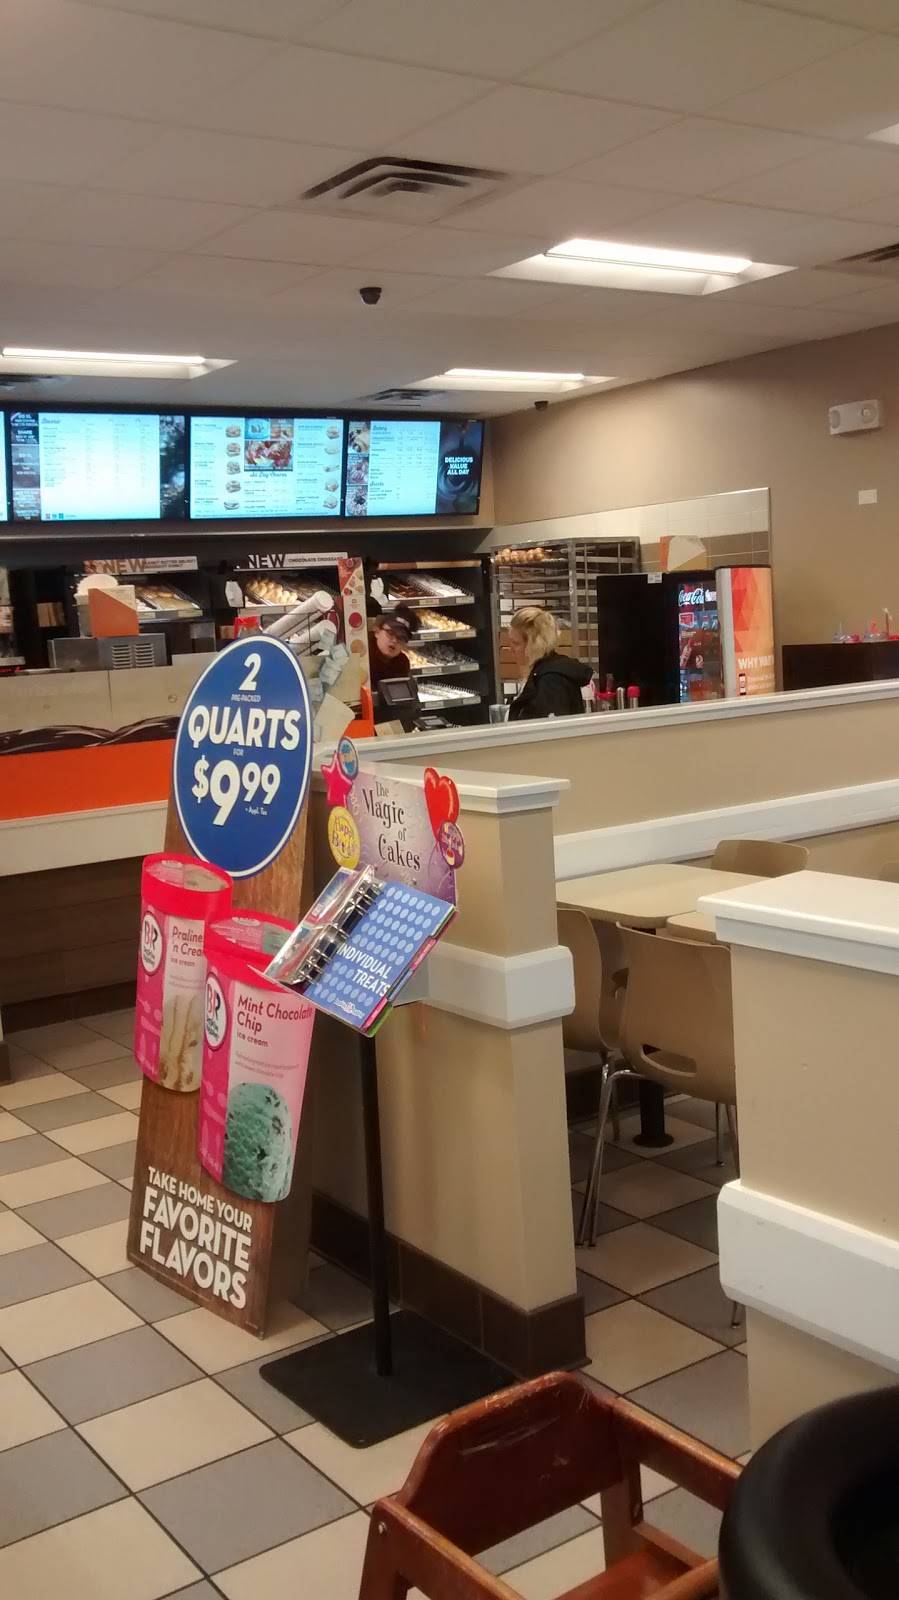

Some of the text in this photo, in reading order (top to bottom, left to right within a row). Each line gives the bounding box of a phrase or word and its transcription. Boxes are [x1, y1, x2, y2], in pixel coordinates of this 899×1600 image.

[102, 558, 145, 573] NEW
[248, 554, 285, 569] NEW
[238, 653, 262, 691] 2
[738, 656, 758, 669] WHY
[188, 705, 300, 751] QUARTS
[232, 748, 244, 757] FOR
[375, 781, 390, 797] The
[362, 788, 405, 829] Magic
[398, 828, 407, 842] of
[378, 834, 421, 871] Cakes
[181, 943, 203, 956] Crea
[336, 942, 392, 979] INDIVIDUAL
[352, 969, 391, 996] TREATS
[238, 996, 263, 1016] Mint
[266, 1003, 313, 1021] Chocolate
[237, 1011, 262, 1035] Chip
[236, 1030, 268, 1048] ice cream
[148, 1166, 252, 1233] TAKE HOME YOUR
[143, 1186, 252, 1272] FAVORITE
[139, 1221, 247, 1309] FLAVORS
